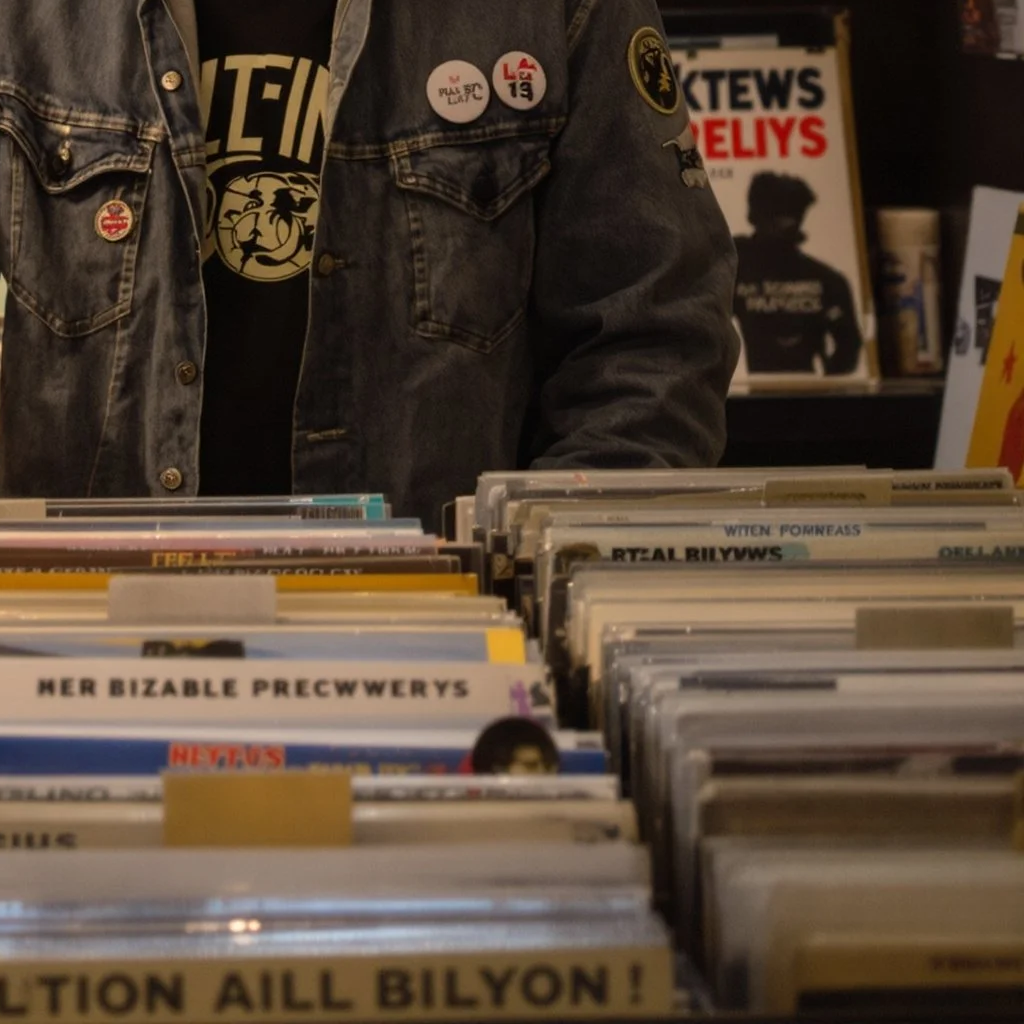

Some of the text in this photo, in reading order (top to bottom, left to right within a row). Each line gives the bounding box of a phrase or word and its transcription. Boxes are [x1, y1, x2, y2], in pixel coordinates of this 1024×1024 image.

[107, 677, 240, 699] BIZABLE
[213, 969, 356, 1016] AILL
[376, 963, 613, 1012] BILYON
